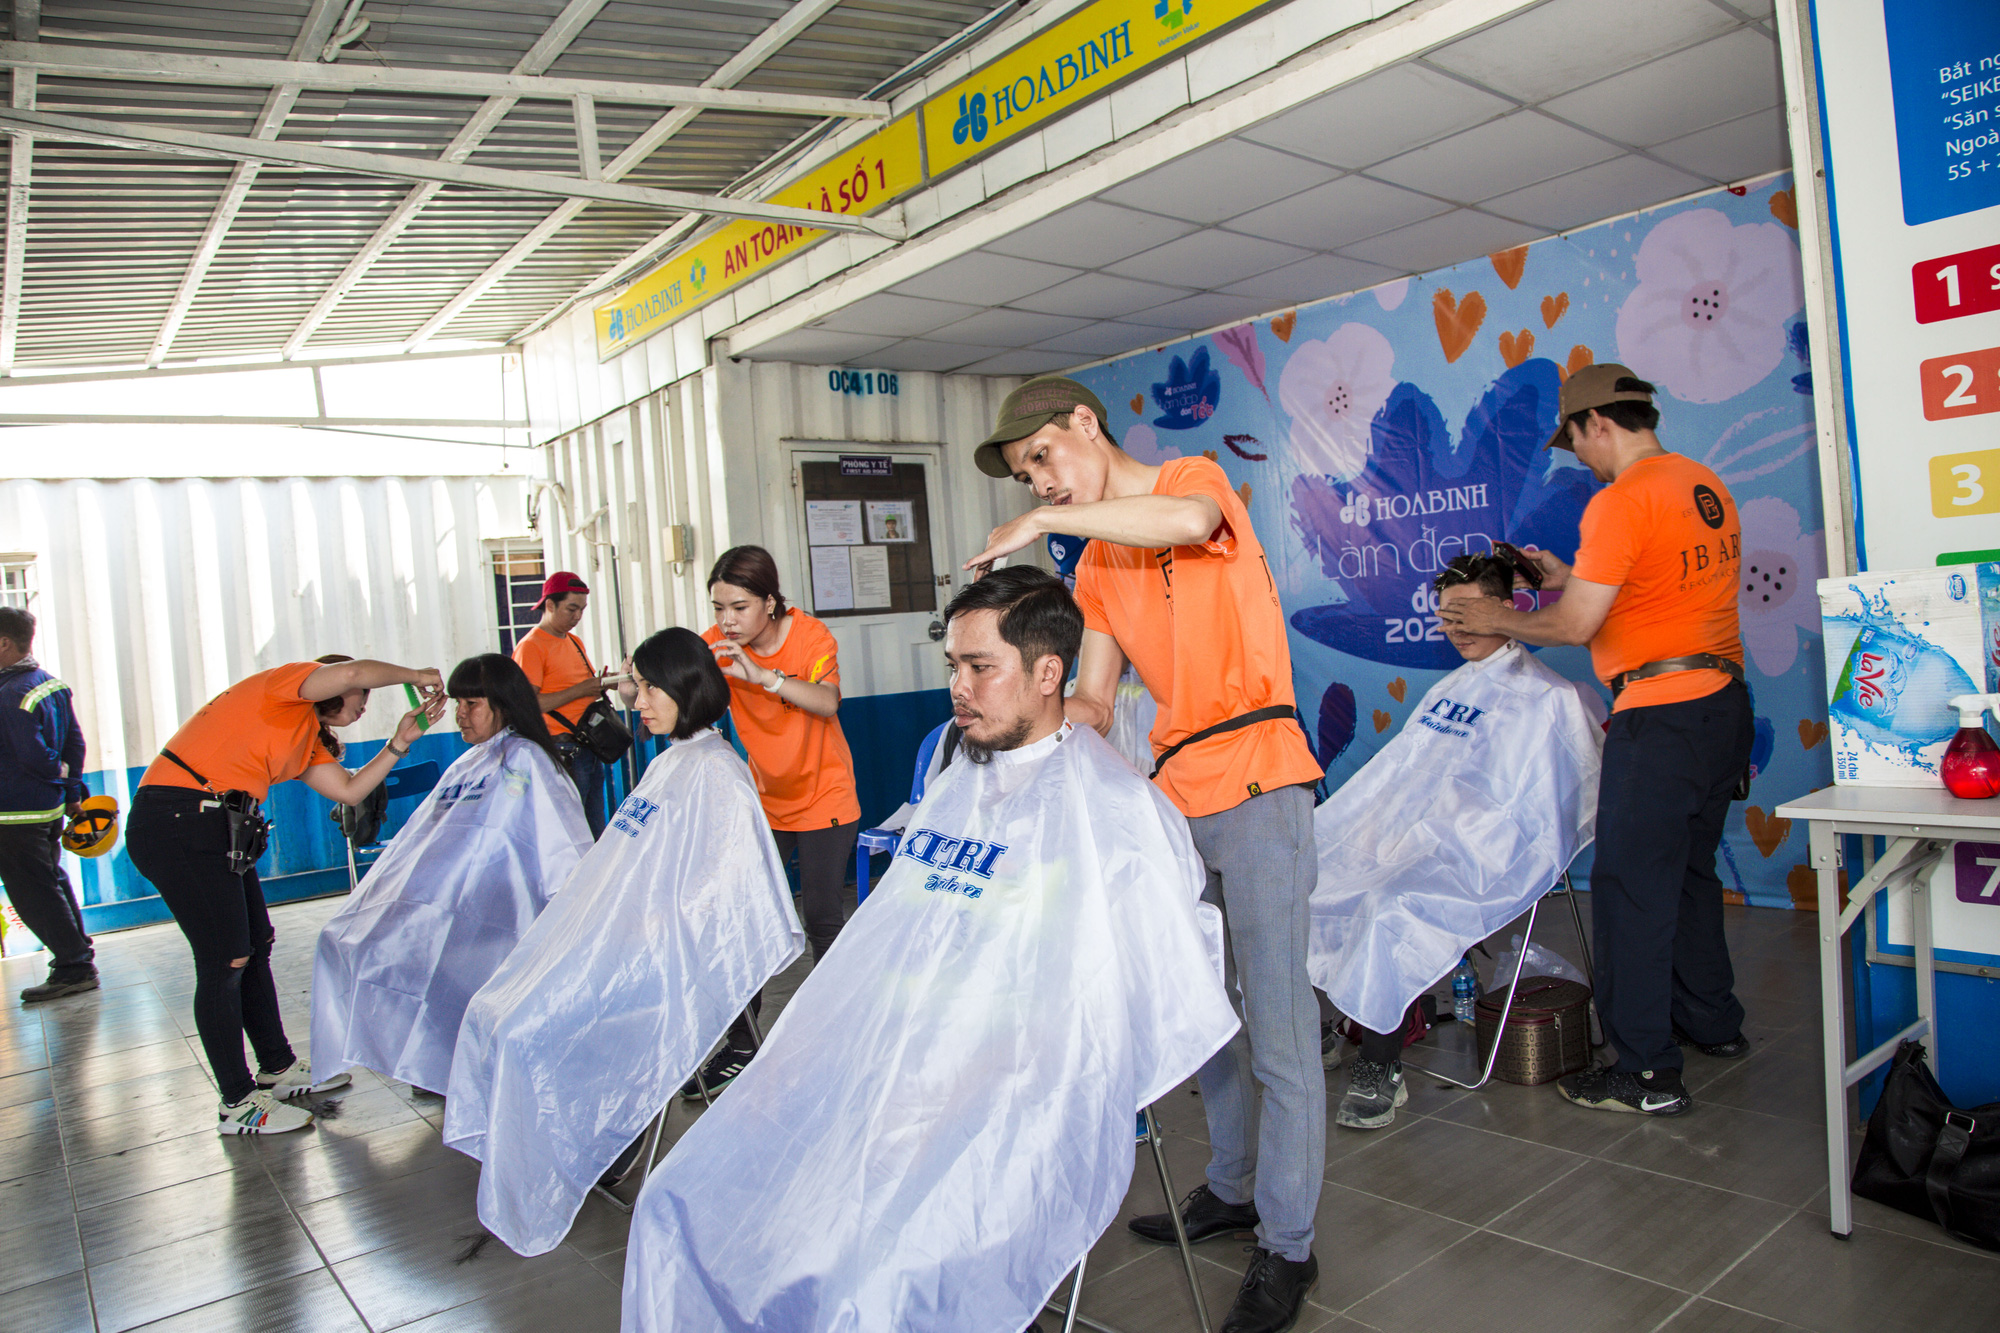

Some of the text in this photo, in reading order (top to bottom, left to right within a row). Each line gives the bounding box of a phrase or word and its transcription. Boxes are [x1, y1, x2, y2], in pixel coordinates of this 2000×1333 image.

[1939, 61, 1972, 84] Bắt
[1948, 161, 1972, 181] 5S
[724, 241, 749, 279] AN
[875, 158, 886, 190] 1
[1936, 264, 1961, 307] 1
[1941, 364, 1978, 408] 2
[1950, 463, 1984, 506] 3
[1316, 533, 1401, 581] Làm
[1719, 532, 1742, 563] AR
[1837, 757, 1847, 770] 350
[1847, 751, 1860, 780] 24 chai
